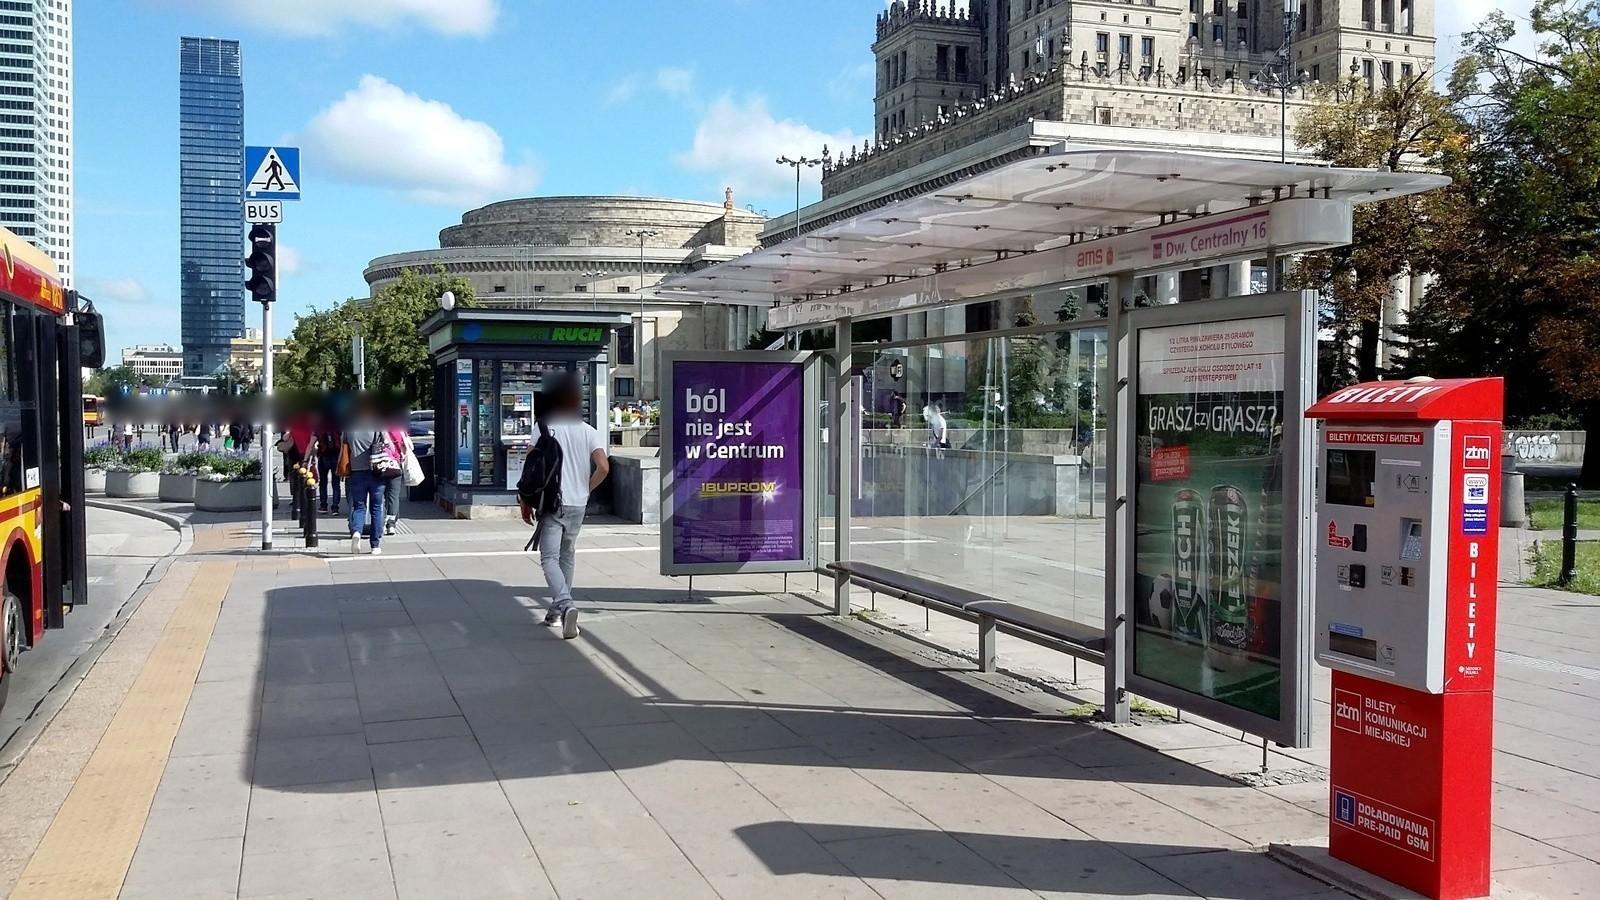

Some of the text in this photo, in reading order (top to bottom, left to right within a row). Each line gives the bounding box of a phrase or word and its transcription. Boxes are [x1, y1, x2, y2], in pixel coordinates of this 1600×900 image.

[247, 205, 279, 219] BUS
[1166, 241, 1187, 258] Dw.
[1190, 226, 1249, 251] Centralny
[1251, 221, 1267, 240] 16
[1077, 248, 1103, 268] ams
[552, 327, 603, 342] RUCH
[1244, 362, 1255, 371] LAT
[686, 387, 726, 413] ból
[1328, 386, 1442, 404] BILETY
[685, 418, 752, 440] nie jest
[1149, 405, 1278, 432] GRASZ czy GRASZ?
[1328, 433, 1352, 442] BILETY
[1356, 433, 1385, 443] TICKETS
[1389, 434, 1421, 443] БИЛЕТЫ
[685, 442, 784, 459] w Centrum
[1465, 446, 1489, 460] ztm
[701, 481, 777, 492] IBUPROM
[1177, 514, 1192, 599] LECH
[1227, 514, 1241, 612] LESZEK
[1466, 541, 1480, 660] BILETY
[1336, 702, 1360, 722] ztm
[1365, 697, 1397, 715] BILETY
[1365, 711, 1428, 739] KOMUNIKACJI
[1365, 725, 1411, 748] MIEJSKIEJ
[1358, 802, 1429, 838] DOŁADOWANIA
[1358, 815, 1430, 852] PRE-PAID GSM
